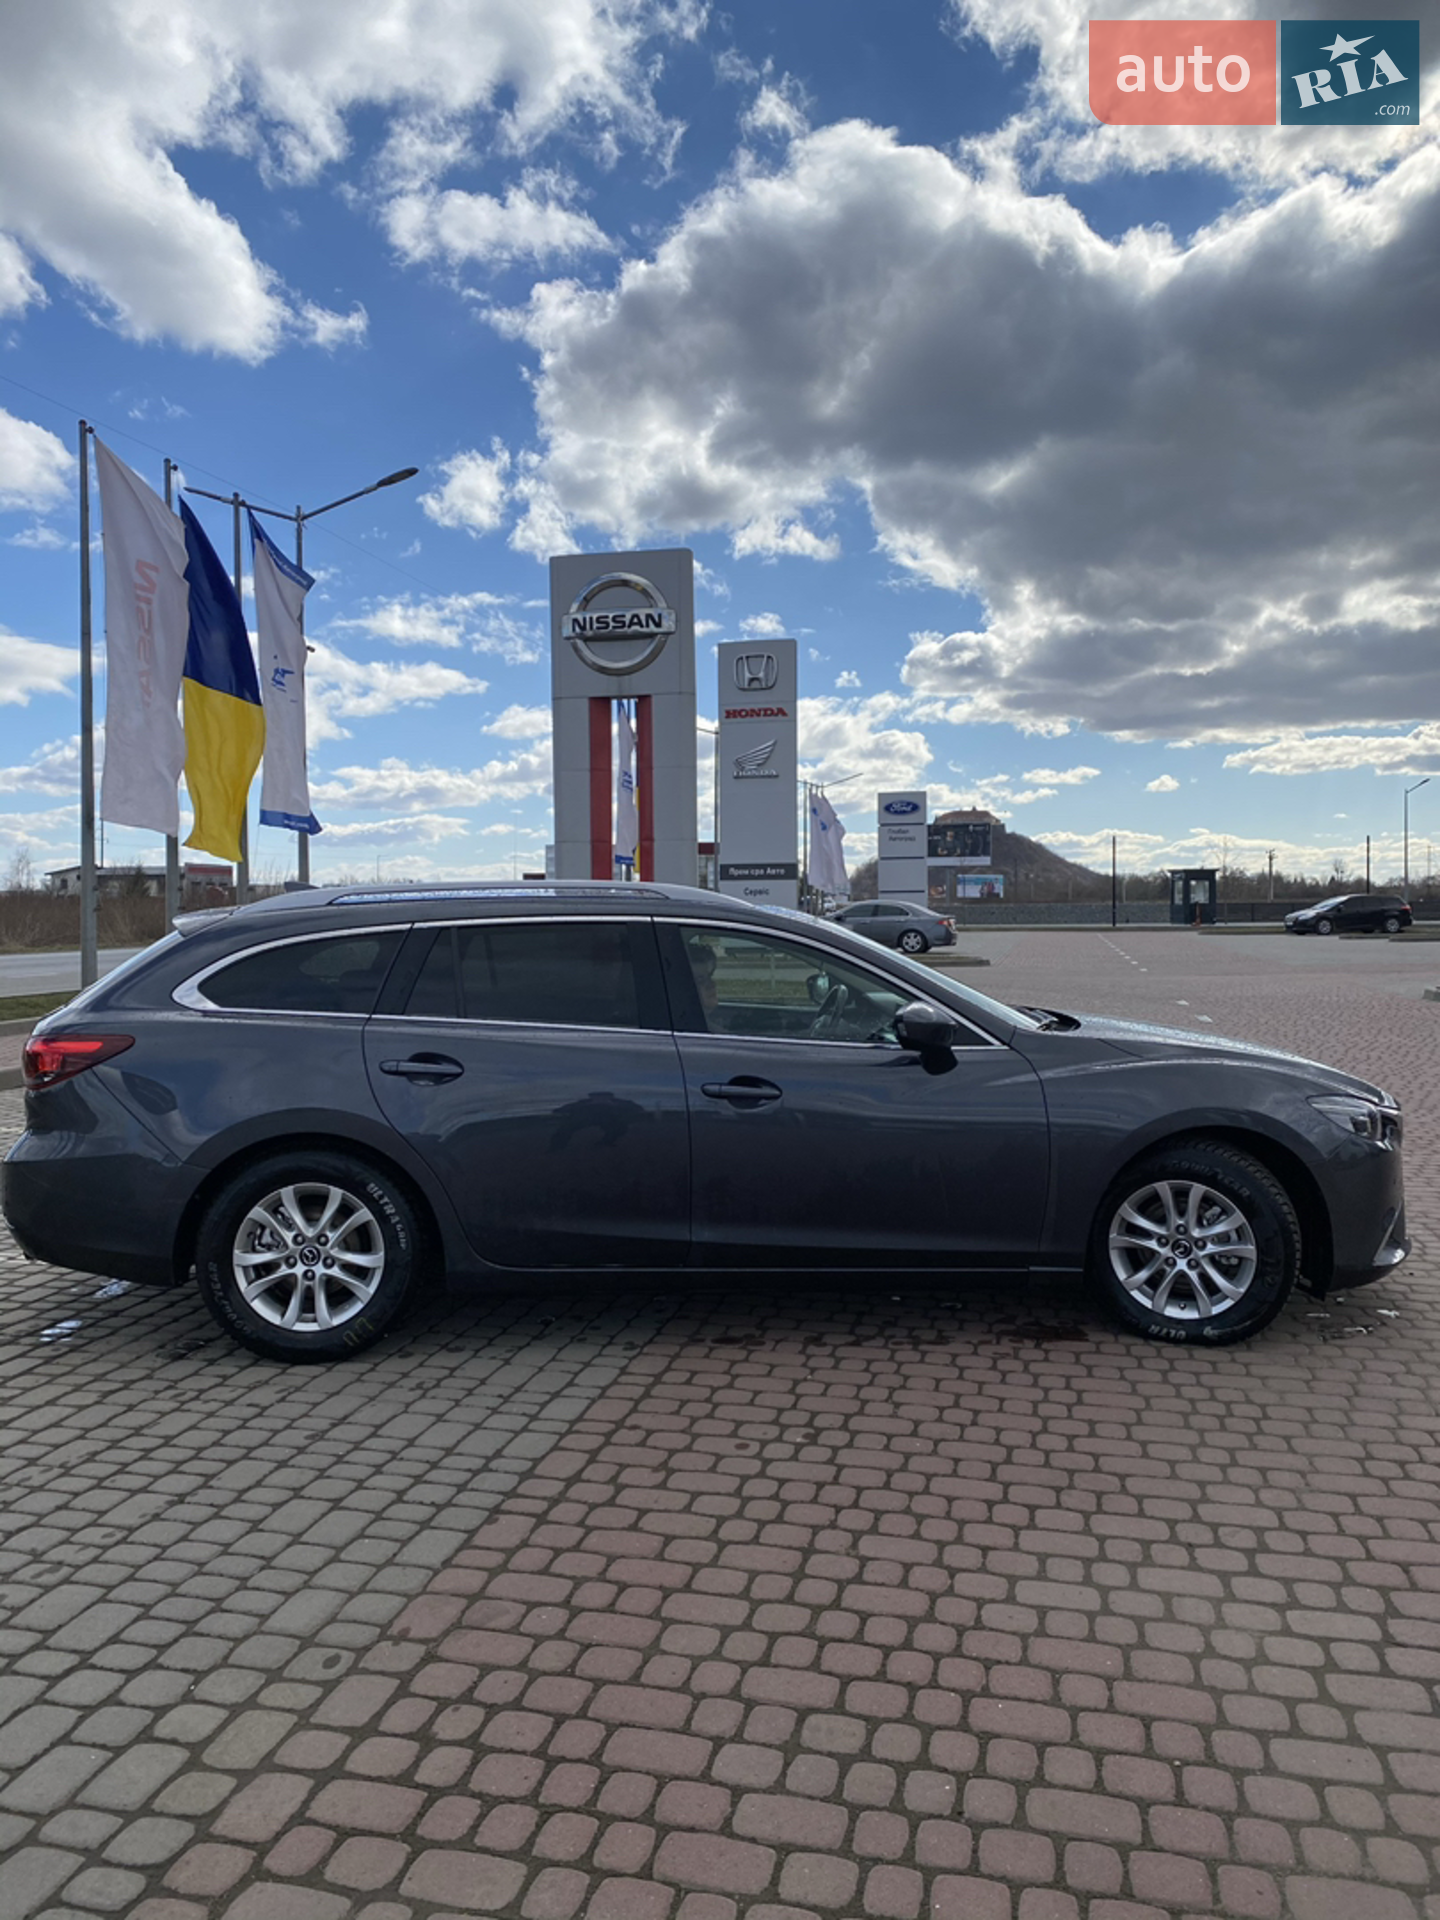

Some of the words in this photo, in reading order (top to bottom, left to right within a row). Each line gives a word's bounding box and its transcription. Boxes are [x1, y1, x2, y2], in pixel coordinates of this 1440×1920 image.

[570, 612, 663, 633] NISSAN
[724, 706, 788, 719] HONDA
[733, 768, 778, 778] HONDA
[889, 801, 914, 813] Ford
[766, 867, 786, 876] Авто
[743, 887, 770, 898] Сервіс
[366, 1181, 401, 1224] ULTRA
